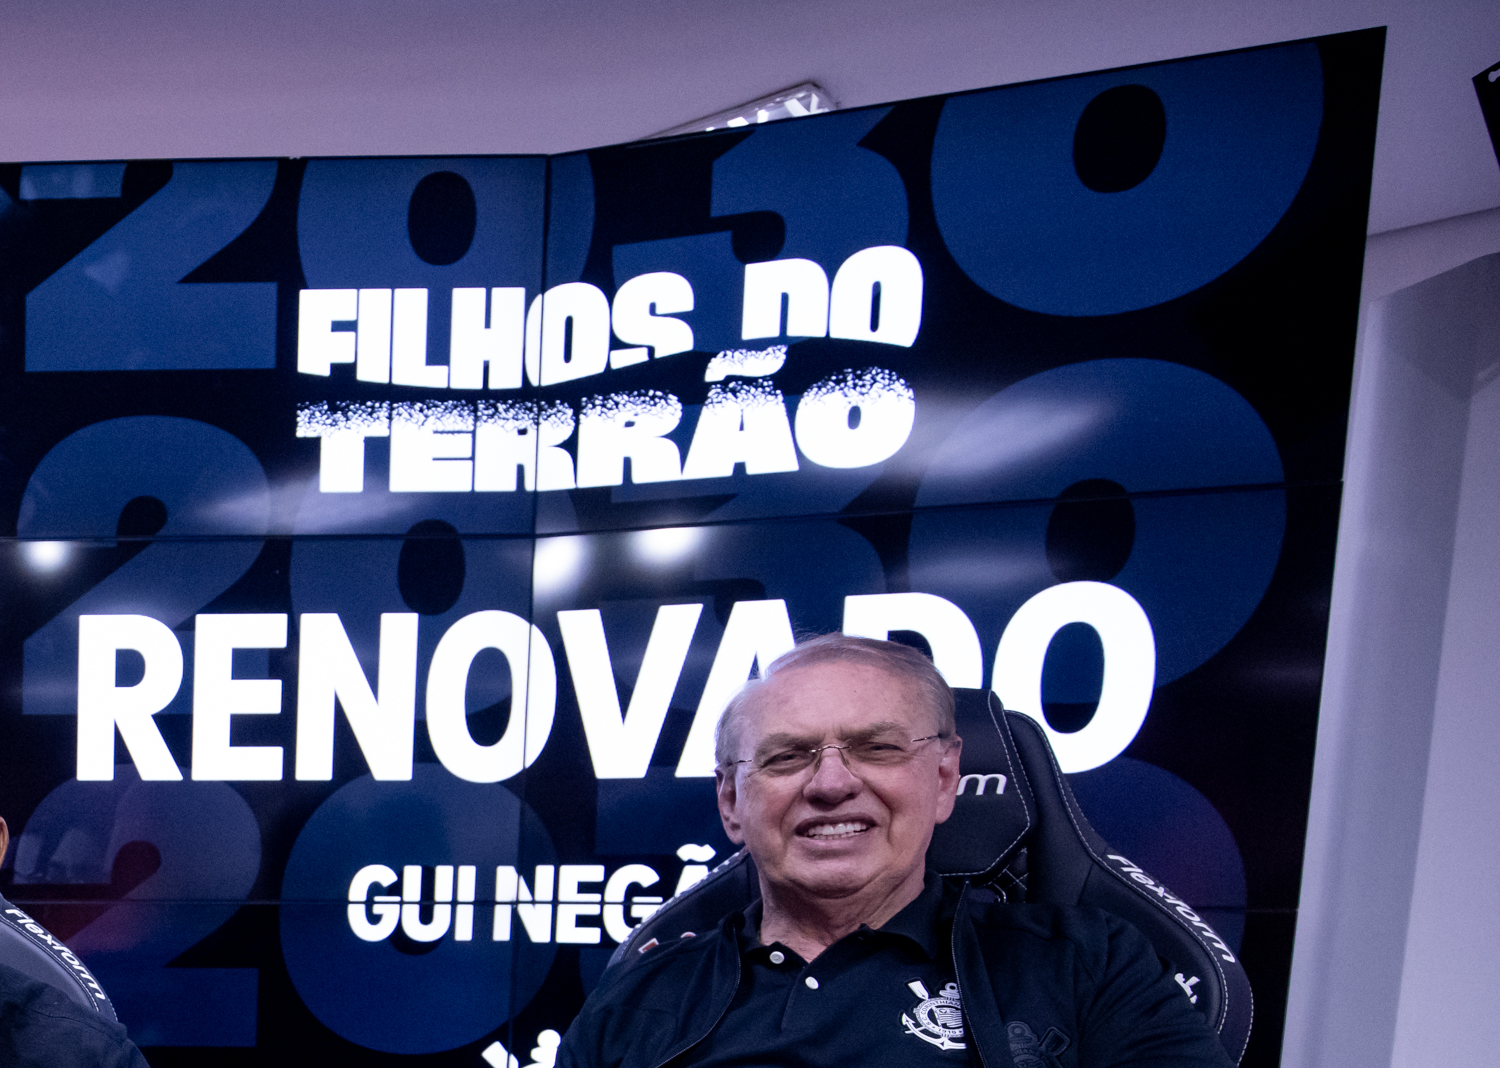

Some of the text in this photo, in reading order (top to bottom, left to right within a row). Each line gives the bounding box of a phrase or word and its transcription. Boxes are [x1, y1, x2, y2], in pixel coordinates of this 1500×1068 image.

[297, 245, 924, 390] FILHOS DO
[296, 345, 915, 494] TERRÃO
[346, 863, 476, 944] GUI
[492, 843, 716, 944] NEG
